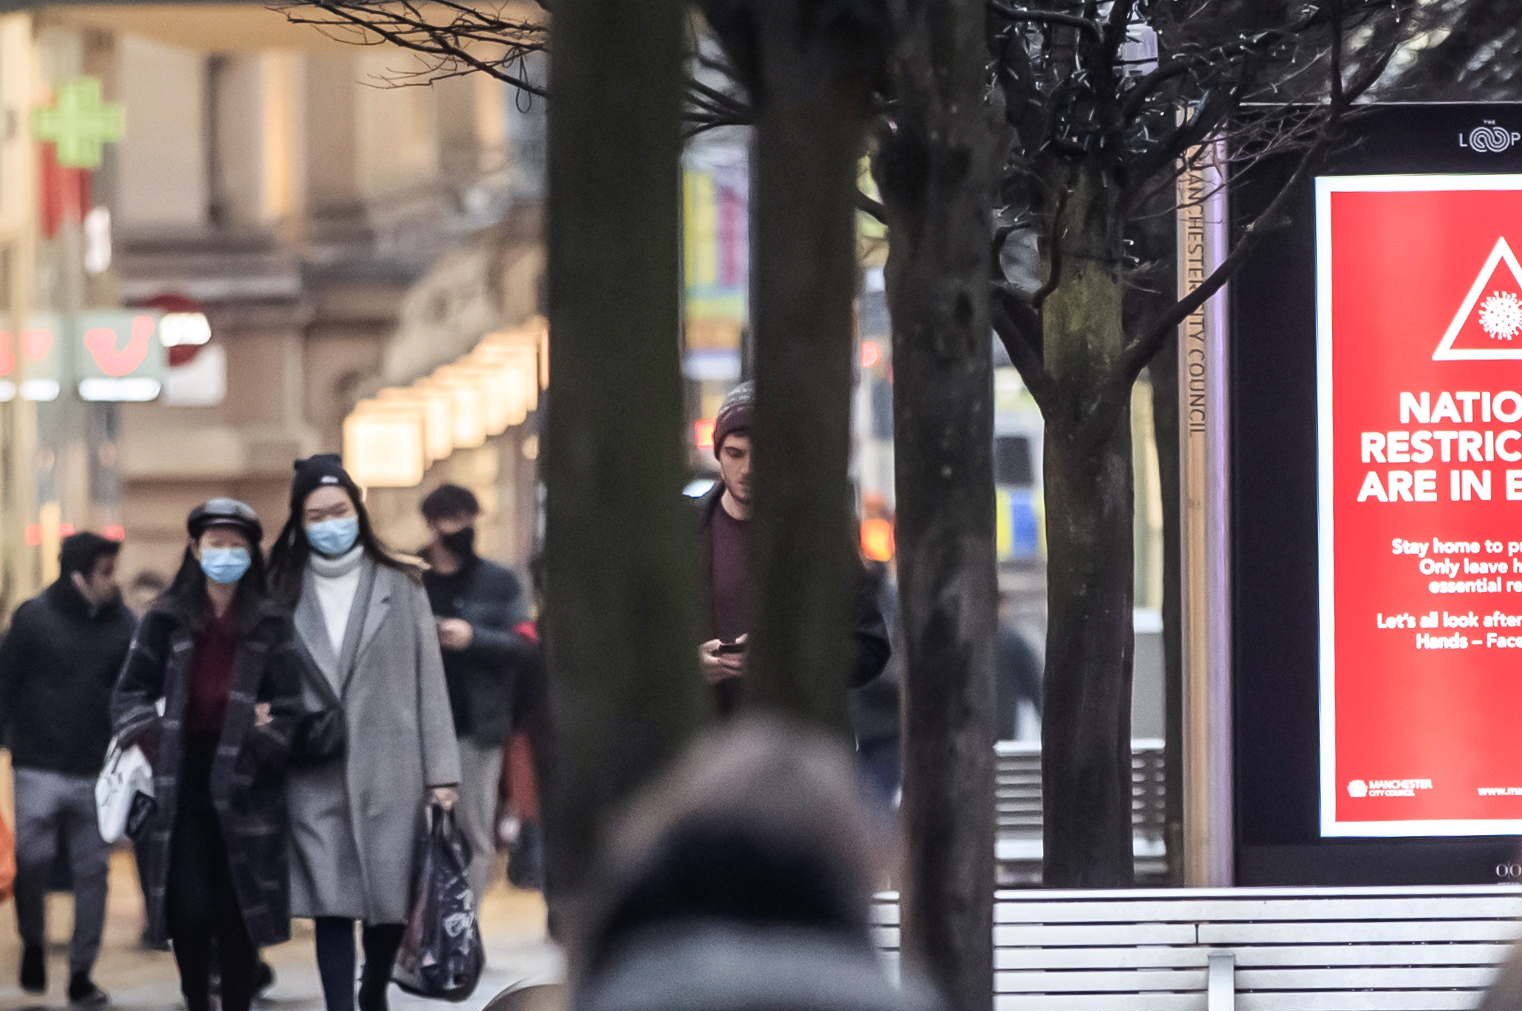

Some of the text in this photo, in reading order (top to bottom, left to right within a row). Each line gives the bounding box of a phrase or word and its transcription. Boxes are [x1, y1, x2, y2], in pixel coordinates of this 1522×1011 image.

[1188, 303, 1205, 342] ITY
[1189, 348, 1206, 436] COUNCIL
[1357, 470, 1437, 502] ARE
[1451, 470, 1491, 501] IN
[1392, 538, 1429, 558] Stay
[1433, 537, 1480, 554] home
[1484, 540, 1503, 553] to
[1419, 558, 1460, 578] Only
[1464, 558, 1508, 573] leave
[1429, 577, 1501, 593] essential
[1377, 612, 1416, 629] Let's
[1420, 611, 1439, 628] all
[1443, 611, 1479, 628] look
[1416, 632, 1468, 649] Hands
[1368, 779, 1433, 790] MANCHESTER
